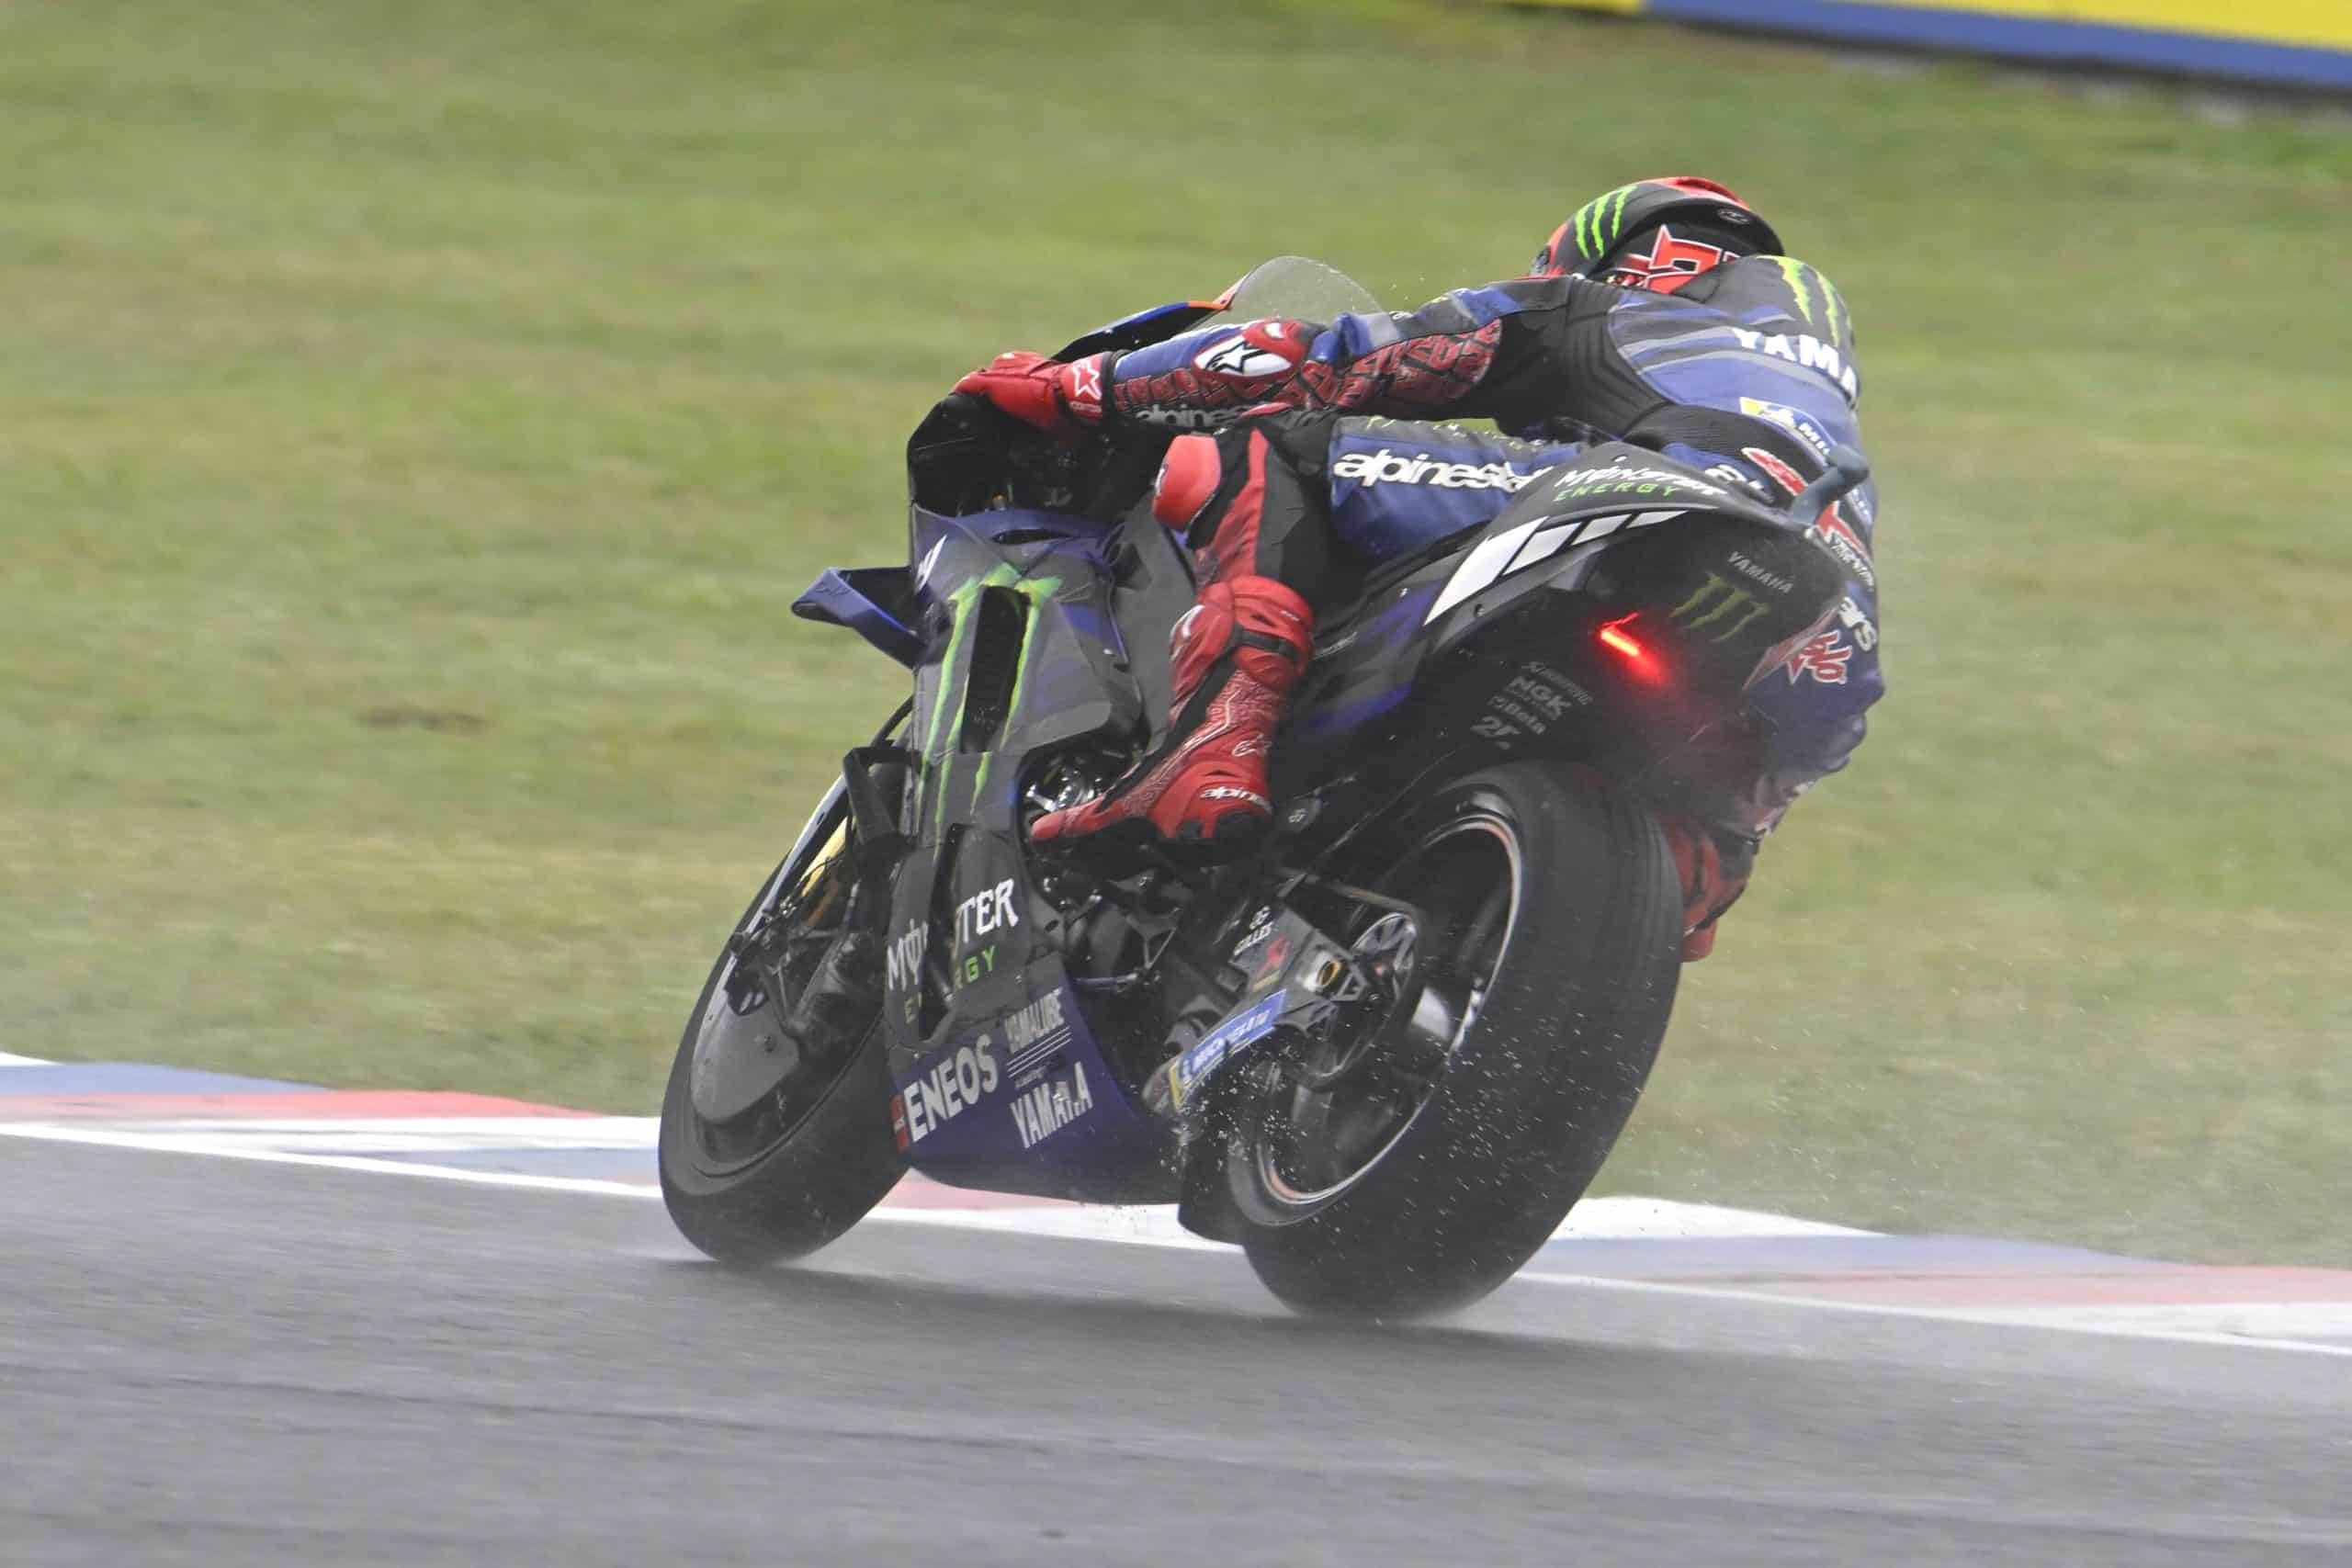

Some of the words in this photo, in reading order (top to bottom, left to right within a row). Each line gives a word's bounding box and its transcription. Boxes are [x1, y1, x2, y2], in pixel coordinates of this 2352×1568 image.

[1732, 327, 1858, 399] YAMA
[1552, 482, 1679, 502] ENERGY
[1727, 551, 1794, 594] YAMAHA
[903, 1033, 999, 1144] ENEOS
